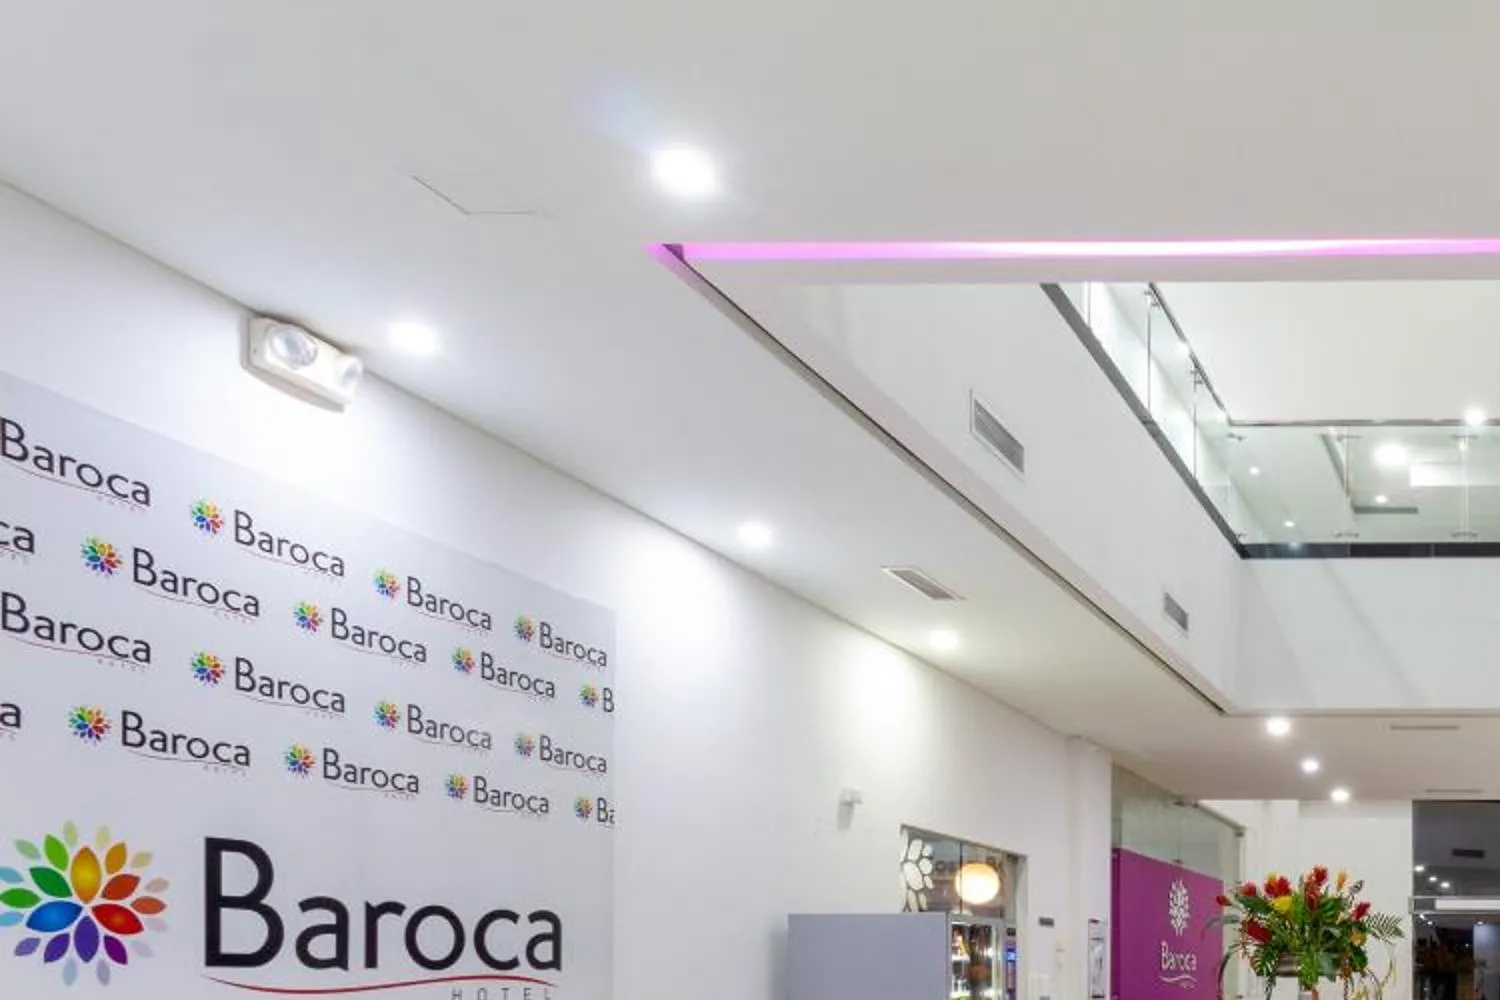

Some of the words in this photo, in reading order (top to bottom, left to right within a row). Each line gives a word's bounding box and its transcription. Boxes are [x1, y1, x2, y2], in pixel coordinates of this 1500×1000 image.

[0, 416, 150, 506] Baroca
[234, 509, 344, 577] Baroca
[133, 547, 261, 617] Baroca
[407, 576, 492, 631] Baroca
[1, 591, 151, 664] Baroca
[331, 607, 428, 663] Baroca
[539, 622, 607, 666] Baroca
[235, 656, 345, 713] Baroca
[481, 652, 555, 698] Baroca
[121, 710, 250, 767] Baroca
[408, 704, 492, 750] Baroca
[540, 735, 607, 773] Baroca
[323, 748, 419, 794] Baroca
[474, 776, 549, 814] Baroca
[204, 836, 562, 972] Baroca
